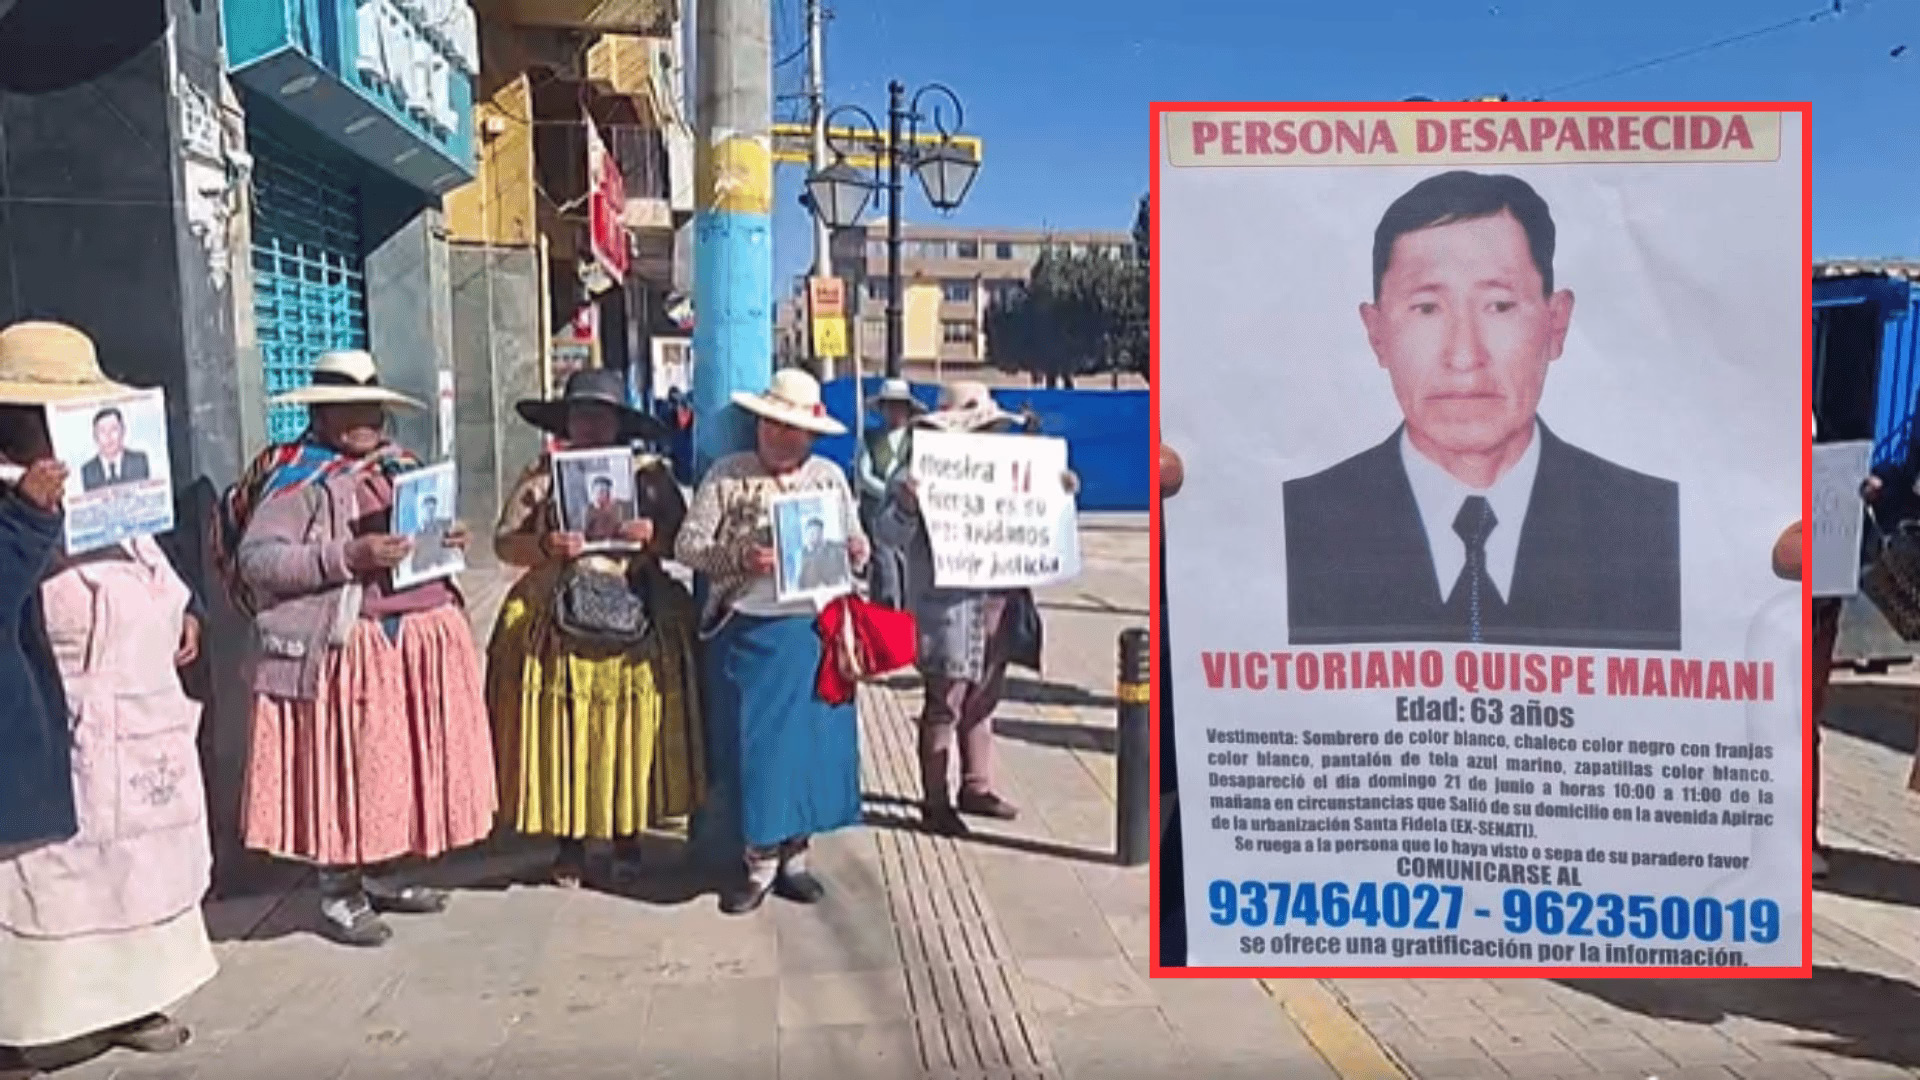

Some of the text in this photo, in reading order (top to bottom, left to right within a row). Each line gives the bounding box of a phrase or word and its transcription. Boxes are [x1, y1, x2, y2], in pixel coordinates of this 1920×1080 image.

[1192, 115, 1754, 155] PERSONA DESAPARECIDA
[1201, 650, 1774, 701] VICTORIANO QUISPE MAMANI
[1396, 696, 1575, 728] Edad: 63 años
[1207, 728, 1774, 760] Vestimenta: Sombrero de color blanco, chaleco color negro con franjas
[1208, 751, 1774, 782] color blanco, pantalón de tela azul marino, zapatillas color blanco.
[1209, 772, 1774, 805] Desapareció el día domingo 21 de junio a horas 10:00 a 11:00 de la
[1210, 795, 1774, 827] mañana en circunstancias que Salió de su domicilio en la avenida Apirac
[1211, 815, 1537, 839] de la urbanización Santa Fidela (EX-SENATI).
[1235, 836, 1750, 870] Se ruega a la persona que lo haya visto o sepa de su paradero favor
[1396, 856, 1582, 887] COMUNICARSE AL
[1208, 879, 1780, 944] 937464027 - 962350019
[1239, 932, 1749, 967] se ofrece una gratificación por la información.
